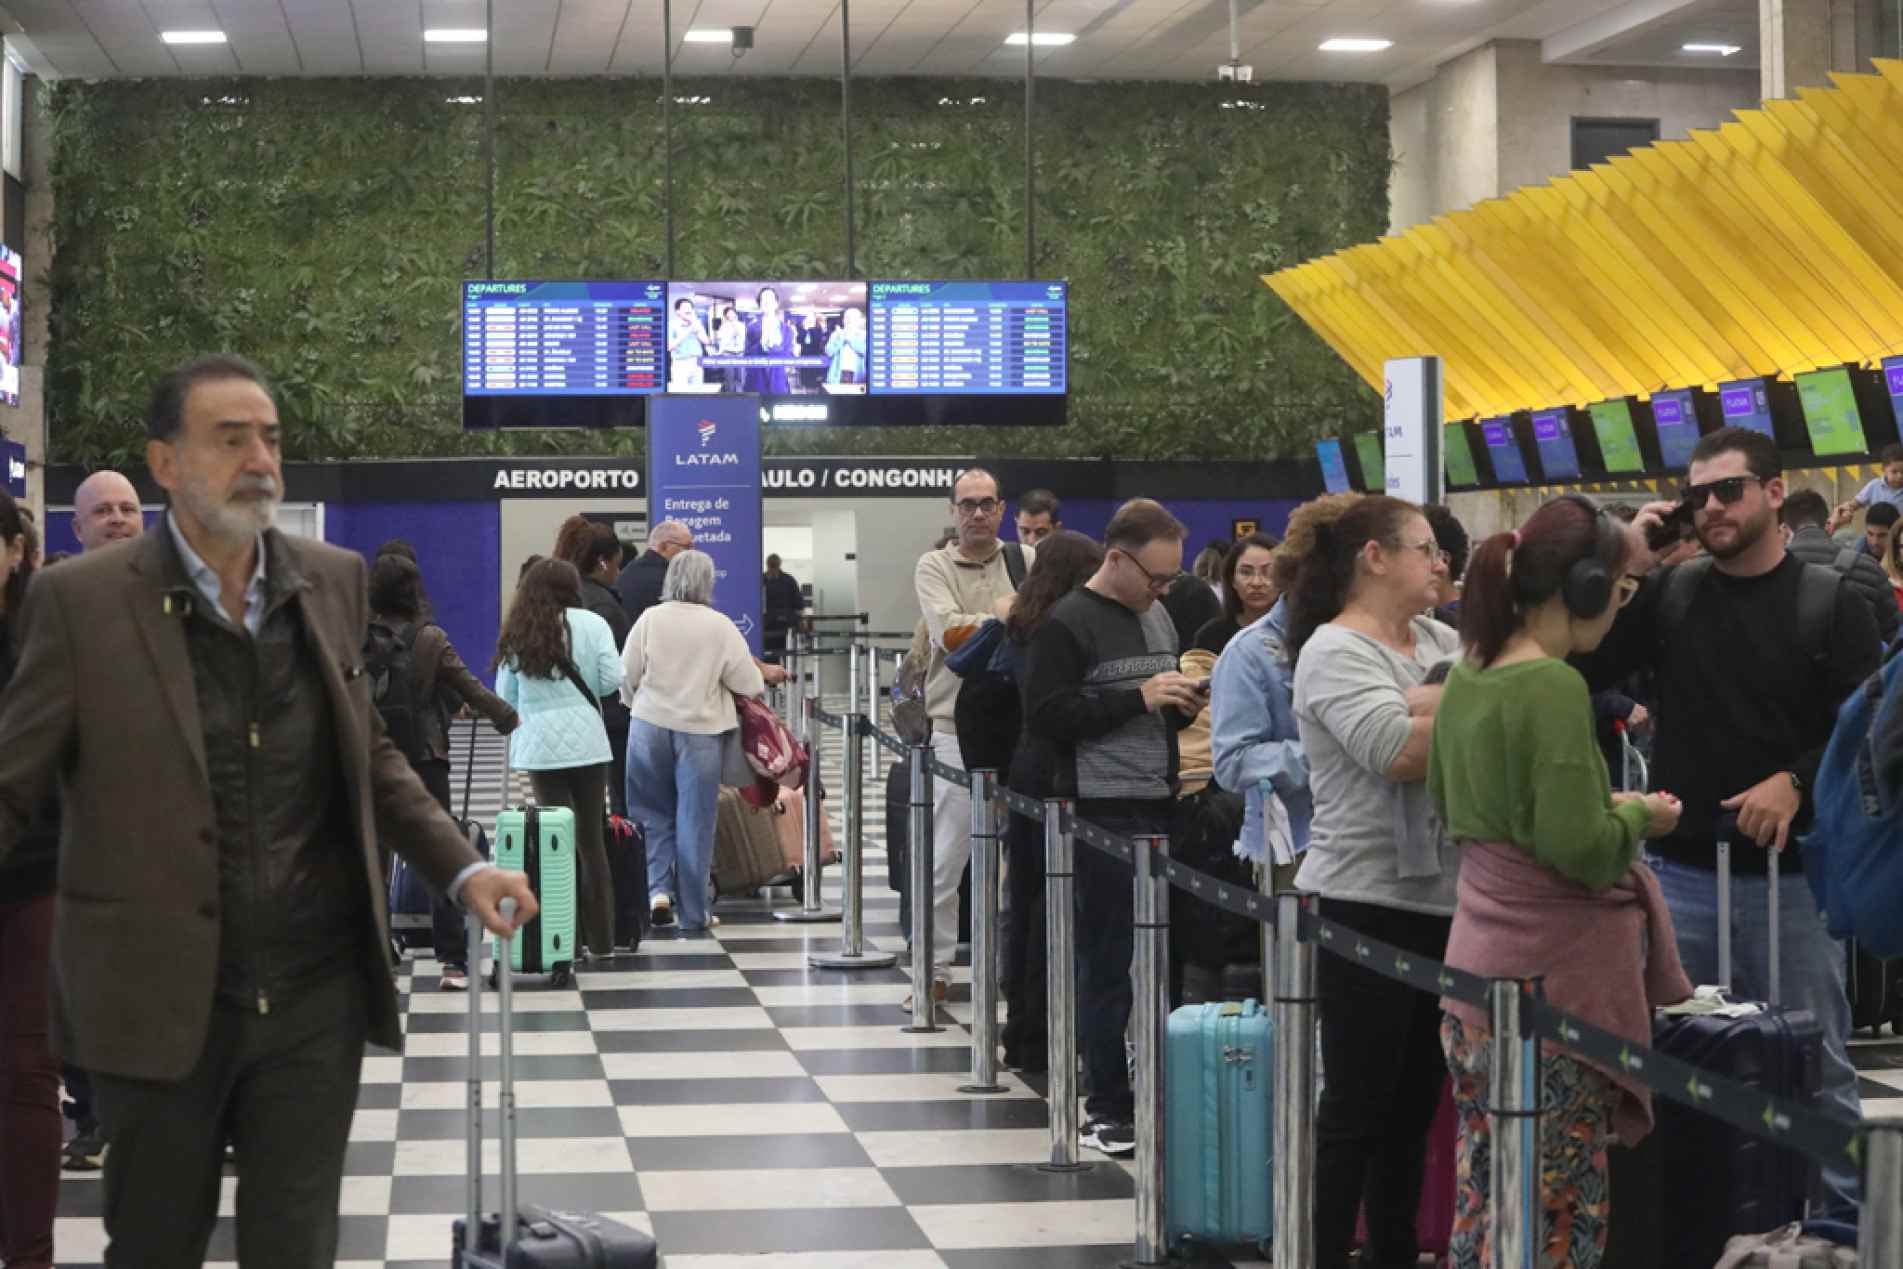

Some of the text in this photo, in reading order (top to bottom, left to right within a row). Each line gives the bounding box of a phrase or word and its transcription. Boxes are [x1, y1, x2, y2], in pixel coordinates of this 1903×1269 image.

[467, 283, 527, 294] DEPARTURES
[873, 283, 931, 294] DEPARTURES
[675, 453, 739, 465] LATAM
[494, 469, 639, 488] AEROPORTO
[762, 469, 814, 488] ULO
[821, 469, 829, 488] /
[664, 497, 729, 513] Entrega de
